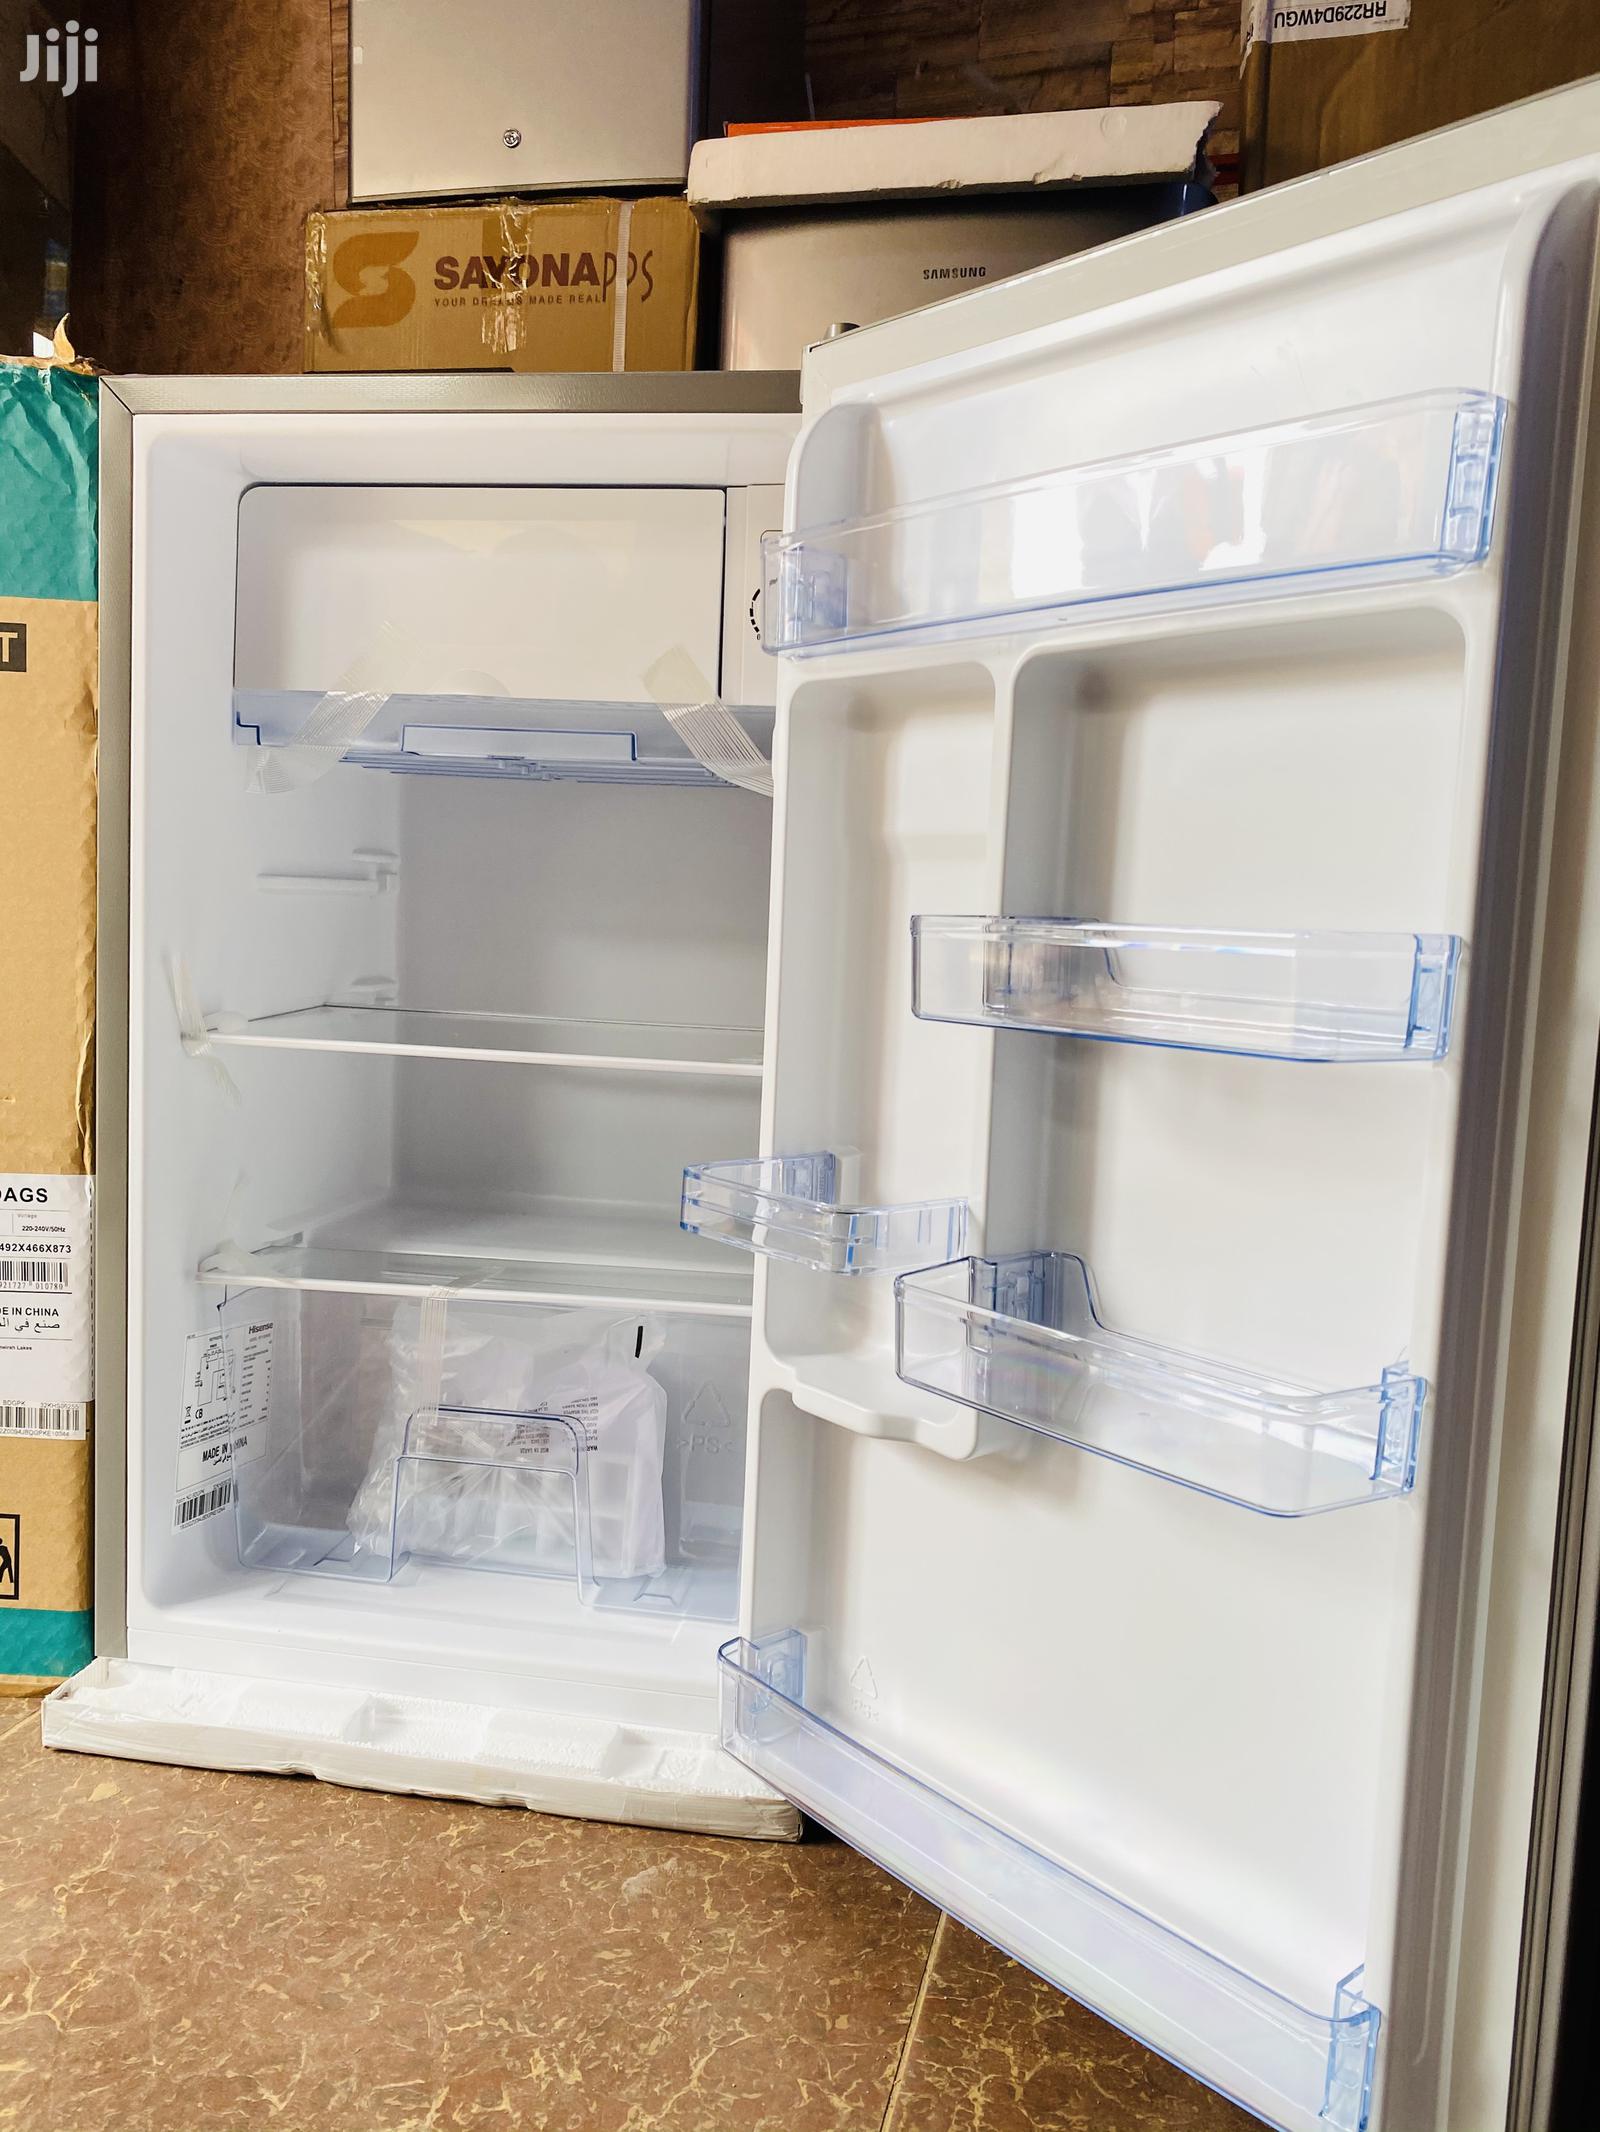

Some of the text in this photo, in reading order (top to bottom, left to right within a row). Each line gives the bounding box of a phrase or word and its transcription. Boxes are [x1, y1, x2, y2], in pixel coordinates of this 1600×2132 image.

[1274, 1, 1387, 28] RR229D4WGU
[434, 252, 600, 292] SAYONA
[923, 266, 987, 280] SAMSUNG
[434, 297, 466, 307] YOUR
[529, 294, 563, 304] MADE
[0, 1187, 48, 1203] AGS
[21, 1225, 66, 1233] 220-240V/50Hz
[11, 1308, 22, 1316] IN
[25, 1308, 59, 1317] CHINA
[248, 1322, 274, 1335] Hisense
[202, 1445, 220, 1463] MADE
